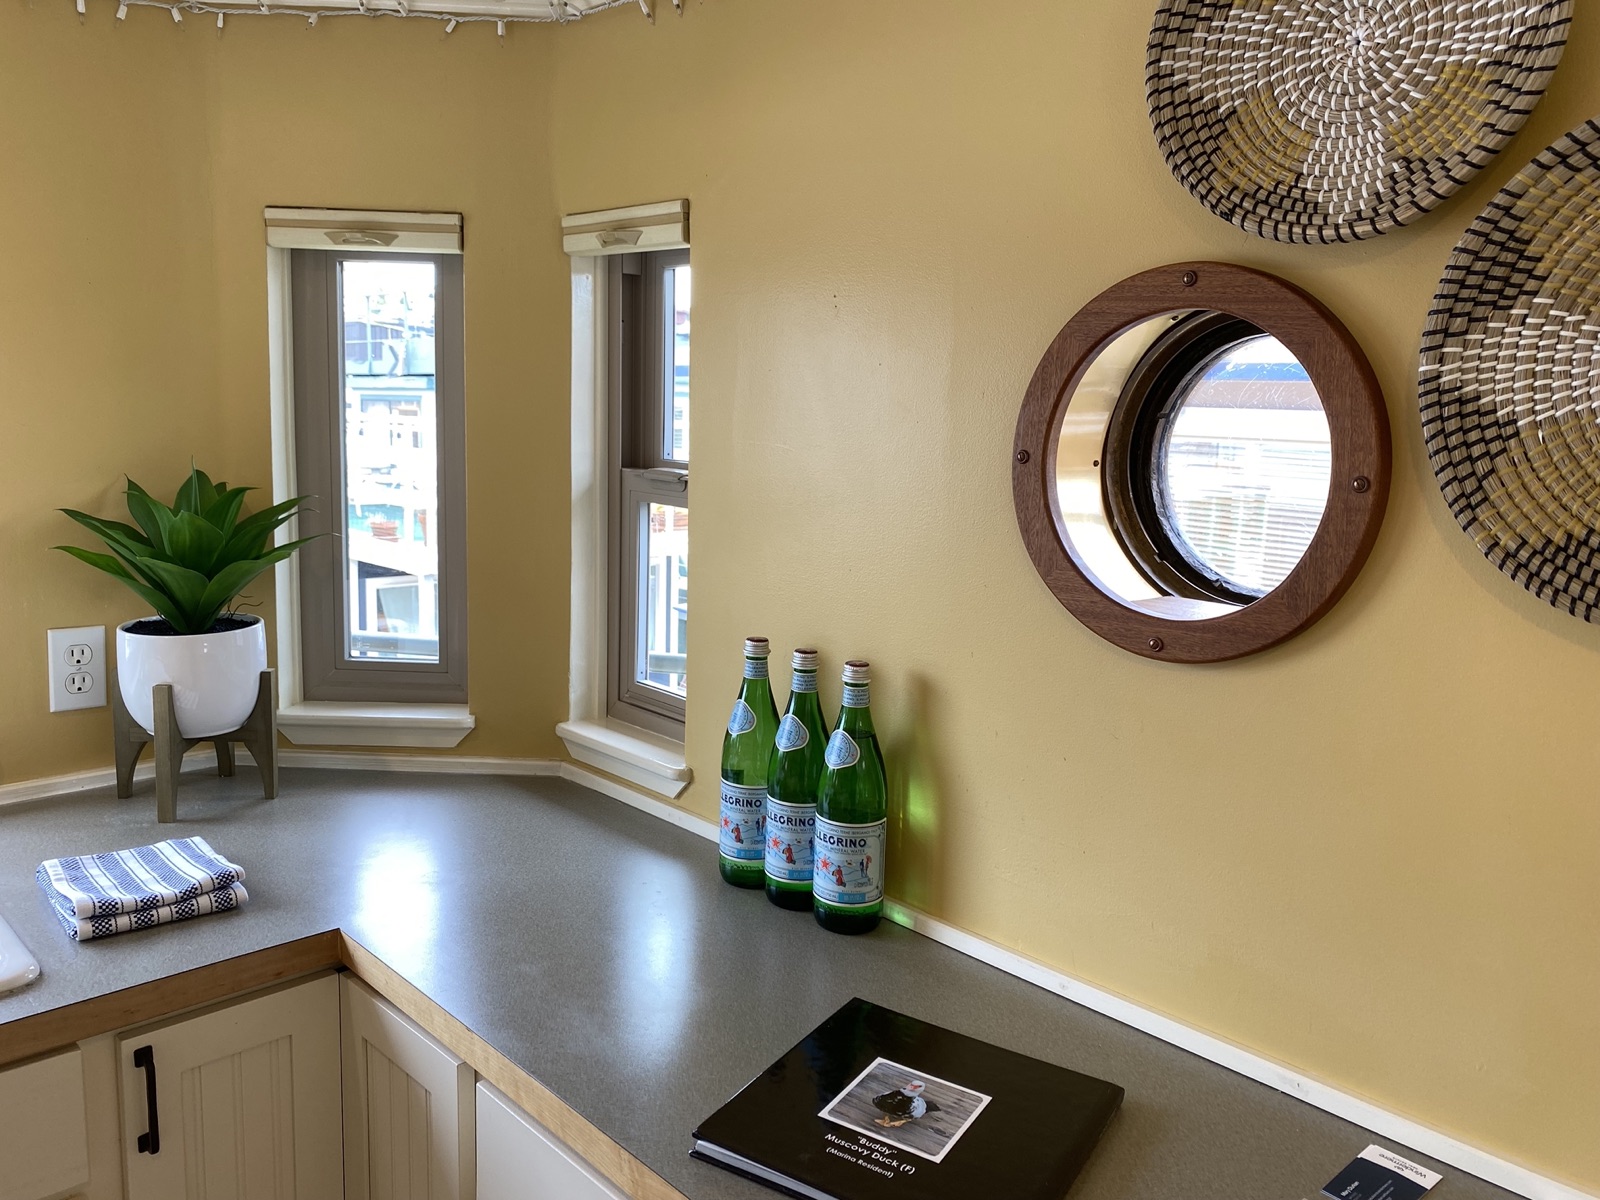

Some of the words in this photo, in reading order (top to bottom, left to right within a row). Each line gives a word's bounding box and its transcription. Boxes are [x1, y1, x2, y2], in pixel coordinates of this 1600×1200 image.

[824, 1134, 870, 1156] Muscovy
[872, 1152, 899, 1167] Duck
[900, 1164, 915, 1175] (F)
[826, 1146, 856, 1162] (Marina
[857, 1160, 894, 1178] Resident)
